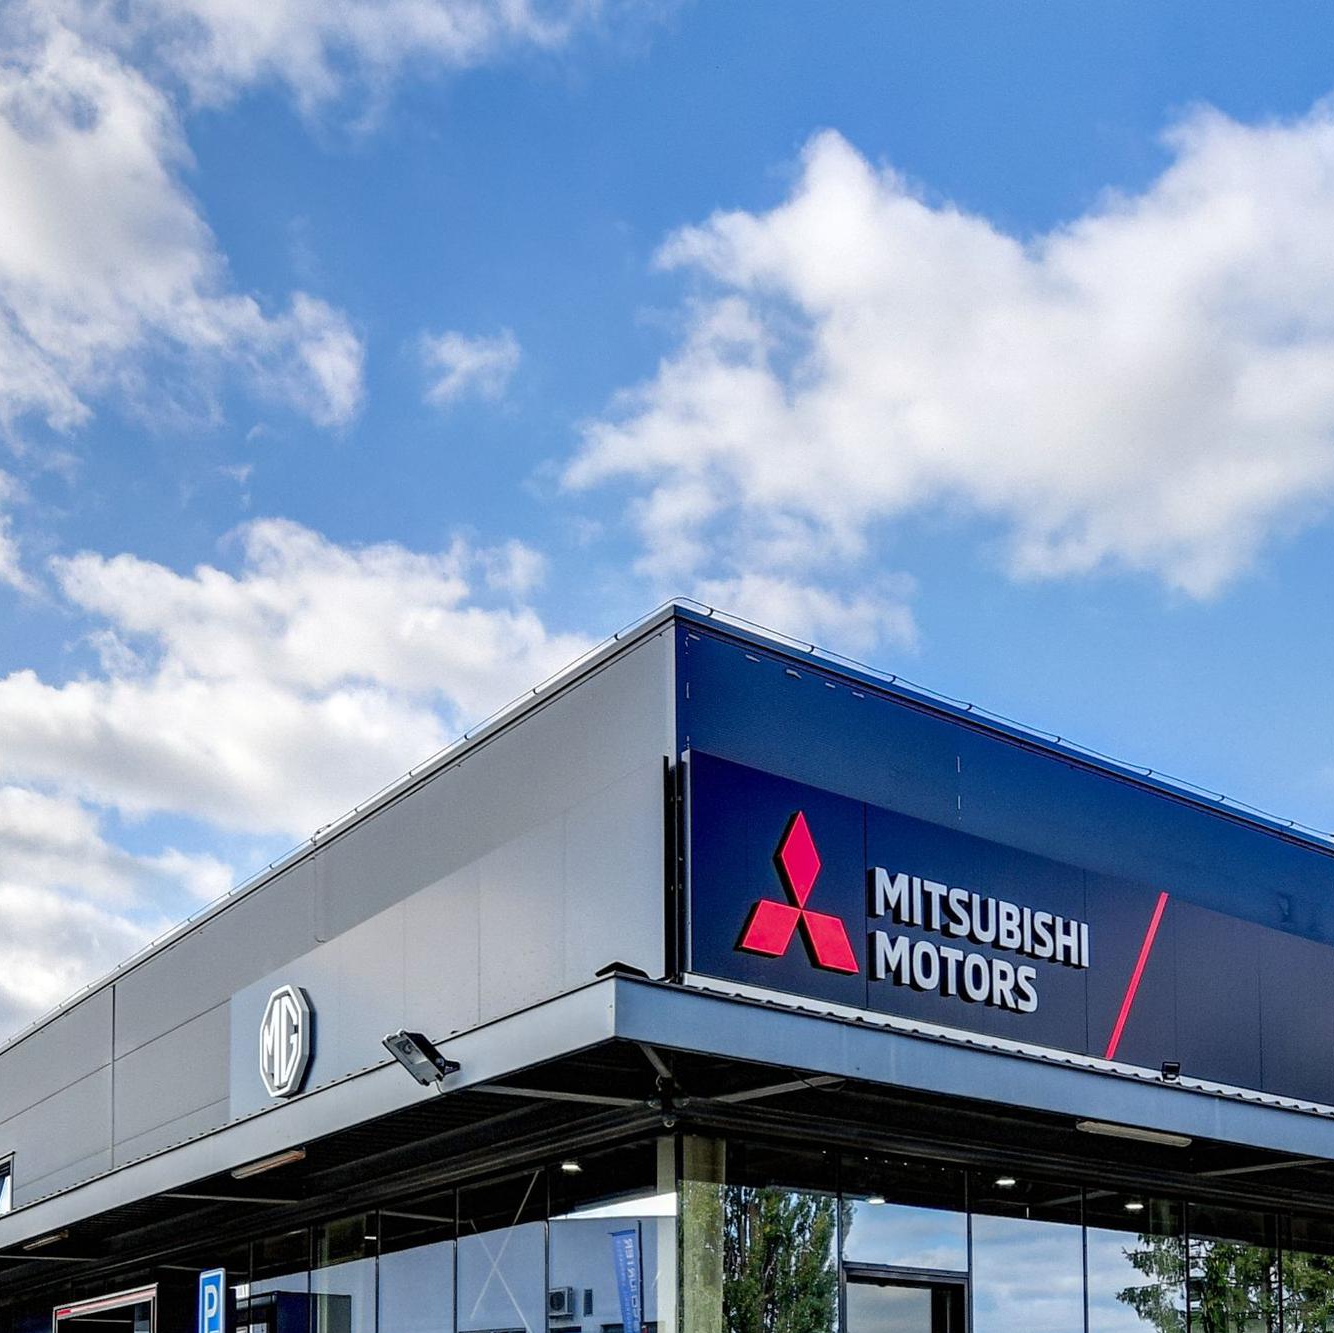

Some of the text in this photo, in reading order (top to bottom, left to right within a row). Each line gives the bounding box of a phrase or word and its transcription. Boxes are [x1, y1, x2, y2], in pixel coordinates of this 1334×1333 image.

[874, 866, 1090, 968] MITSUBISHI
[875, 929, 1039, 1013] MOTORS
[262, 995, 299, 1088] MG
